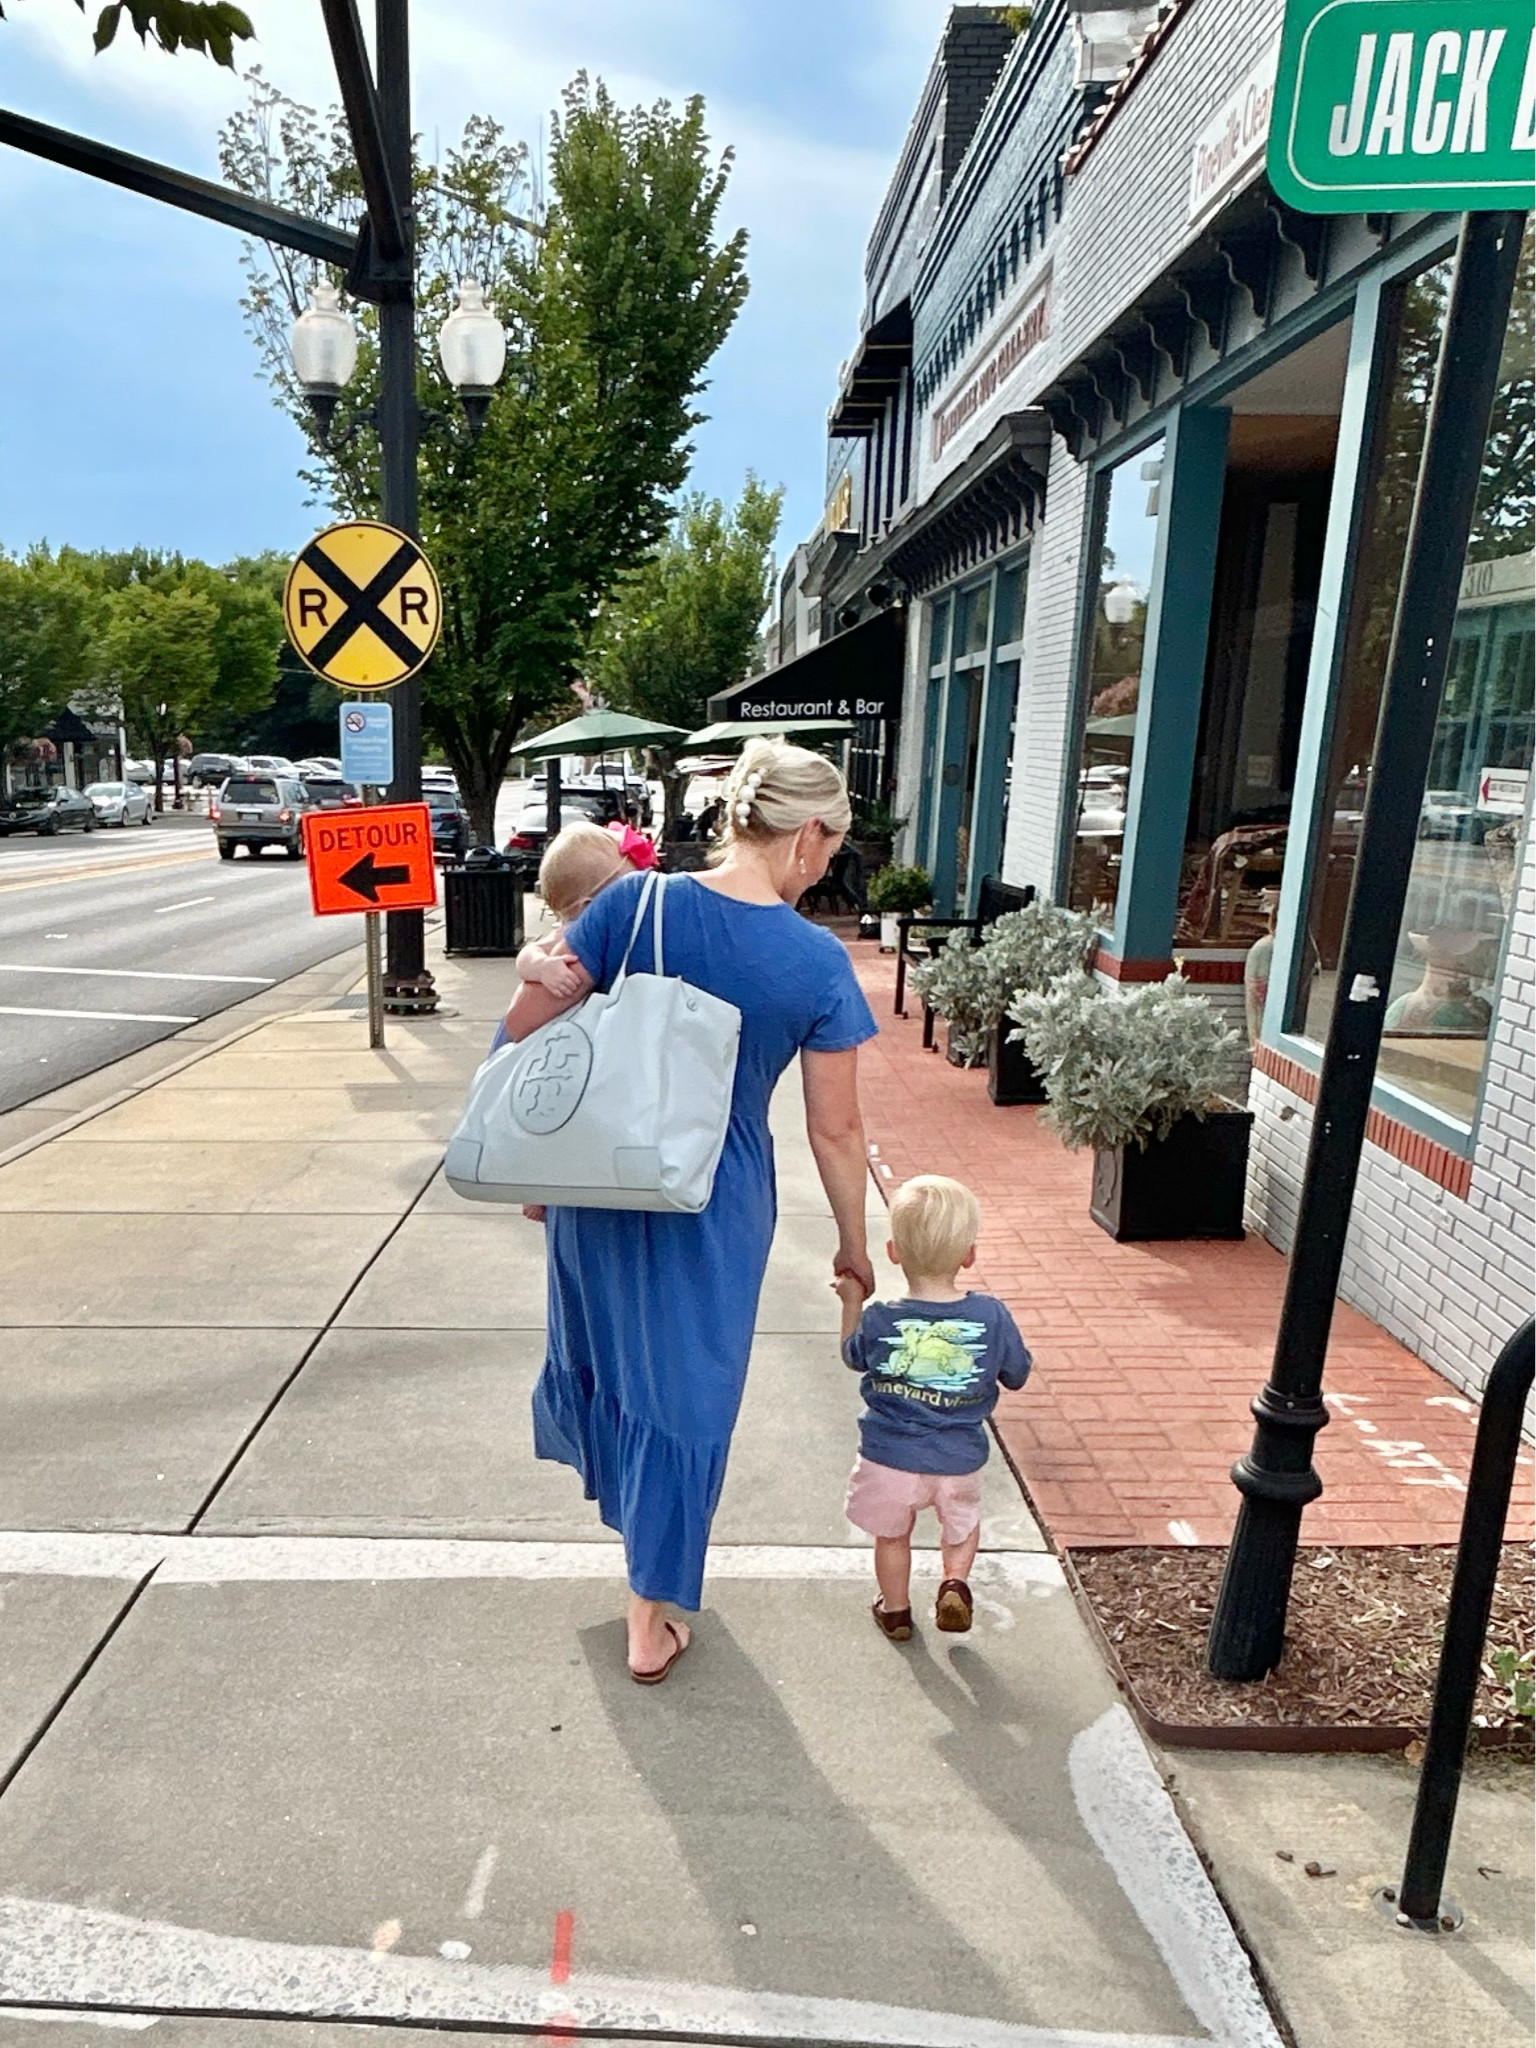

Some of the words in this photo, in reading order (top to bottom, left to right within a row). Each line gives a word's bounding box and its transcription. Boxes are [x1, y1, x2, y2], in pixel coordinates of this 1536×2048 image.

[1328, 28, 1508, 157] JACK
[299, 588, 329, 627] R
[400, 586, 429, 625] R
[740, 699, 833, 718] Restaurant
[836, 699, 851, 715] &
[855, 698, 885, 715] Bar
[319, 822, 419, 853] DETOUR
